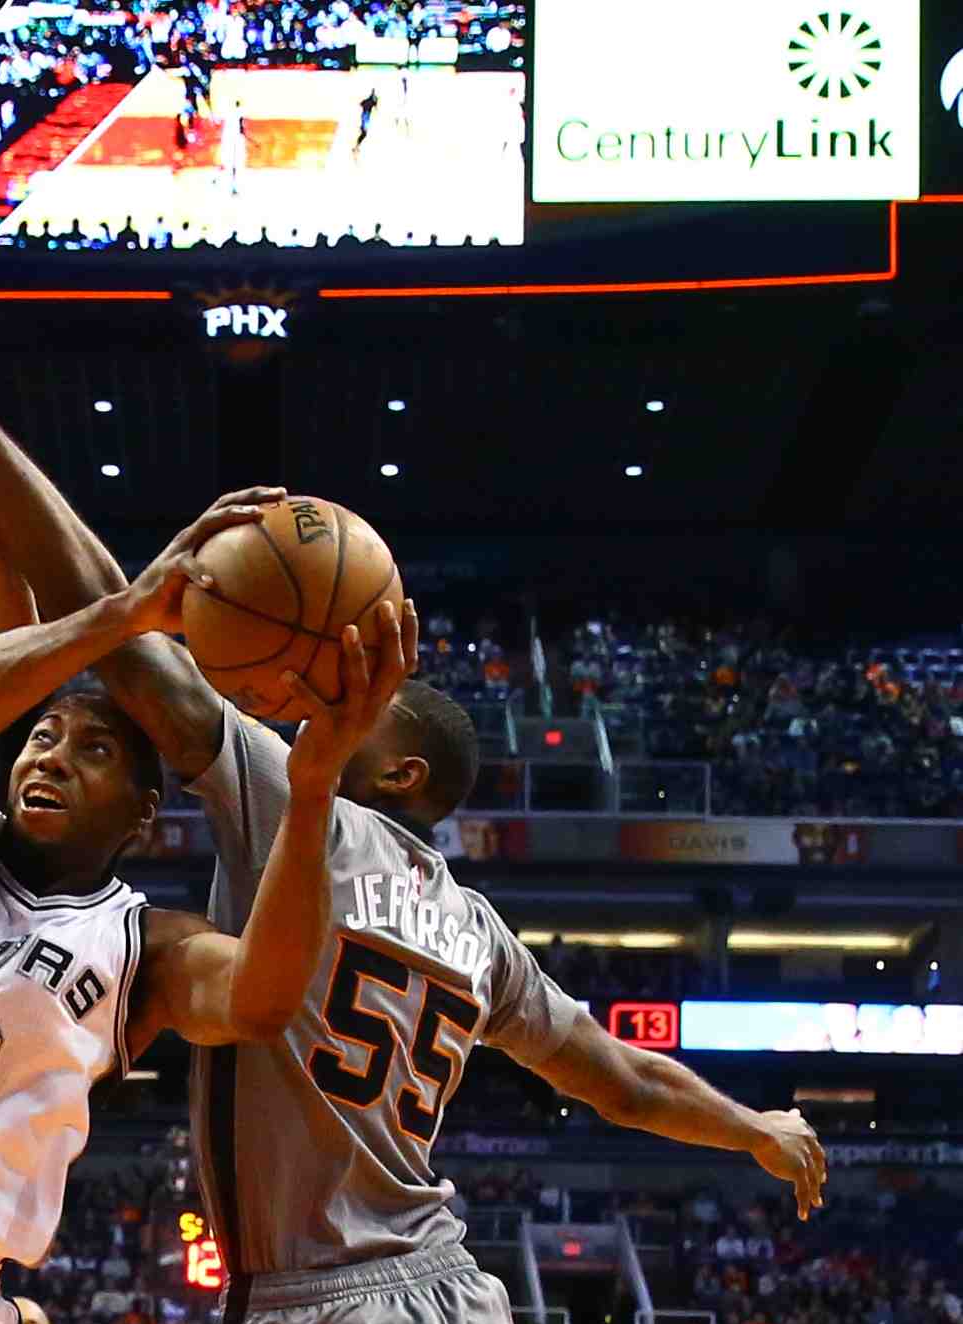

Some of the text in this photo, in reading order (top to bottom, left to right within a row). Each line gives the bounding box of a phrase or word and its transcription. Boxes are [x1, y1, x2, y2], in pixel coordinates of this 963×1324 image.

[556, 117, 894, 170] CenturyLink
[203, 303, 289, 338] PHX
[305, 934, 483, 1146] 55
[630, 1012, 668, 1041] 13
